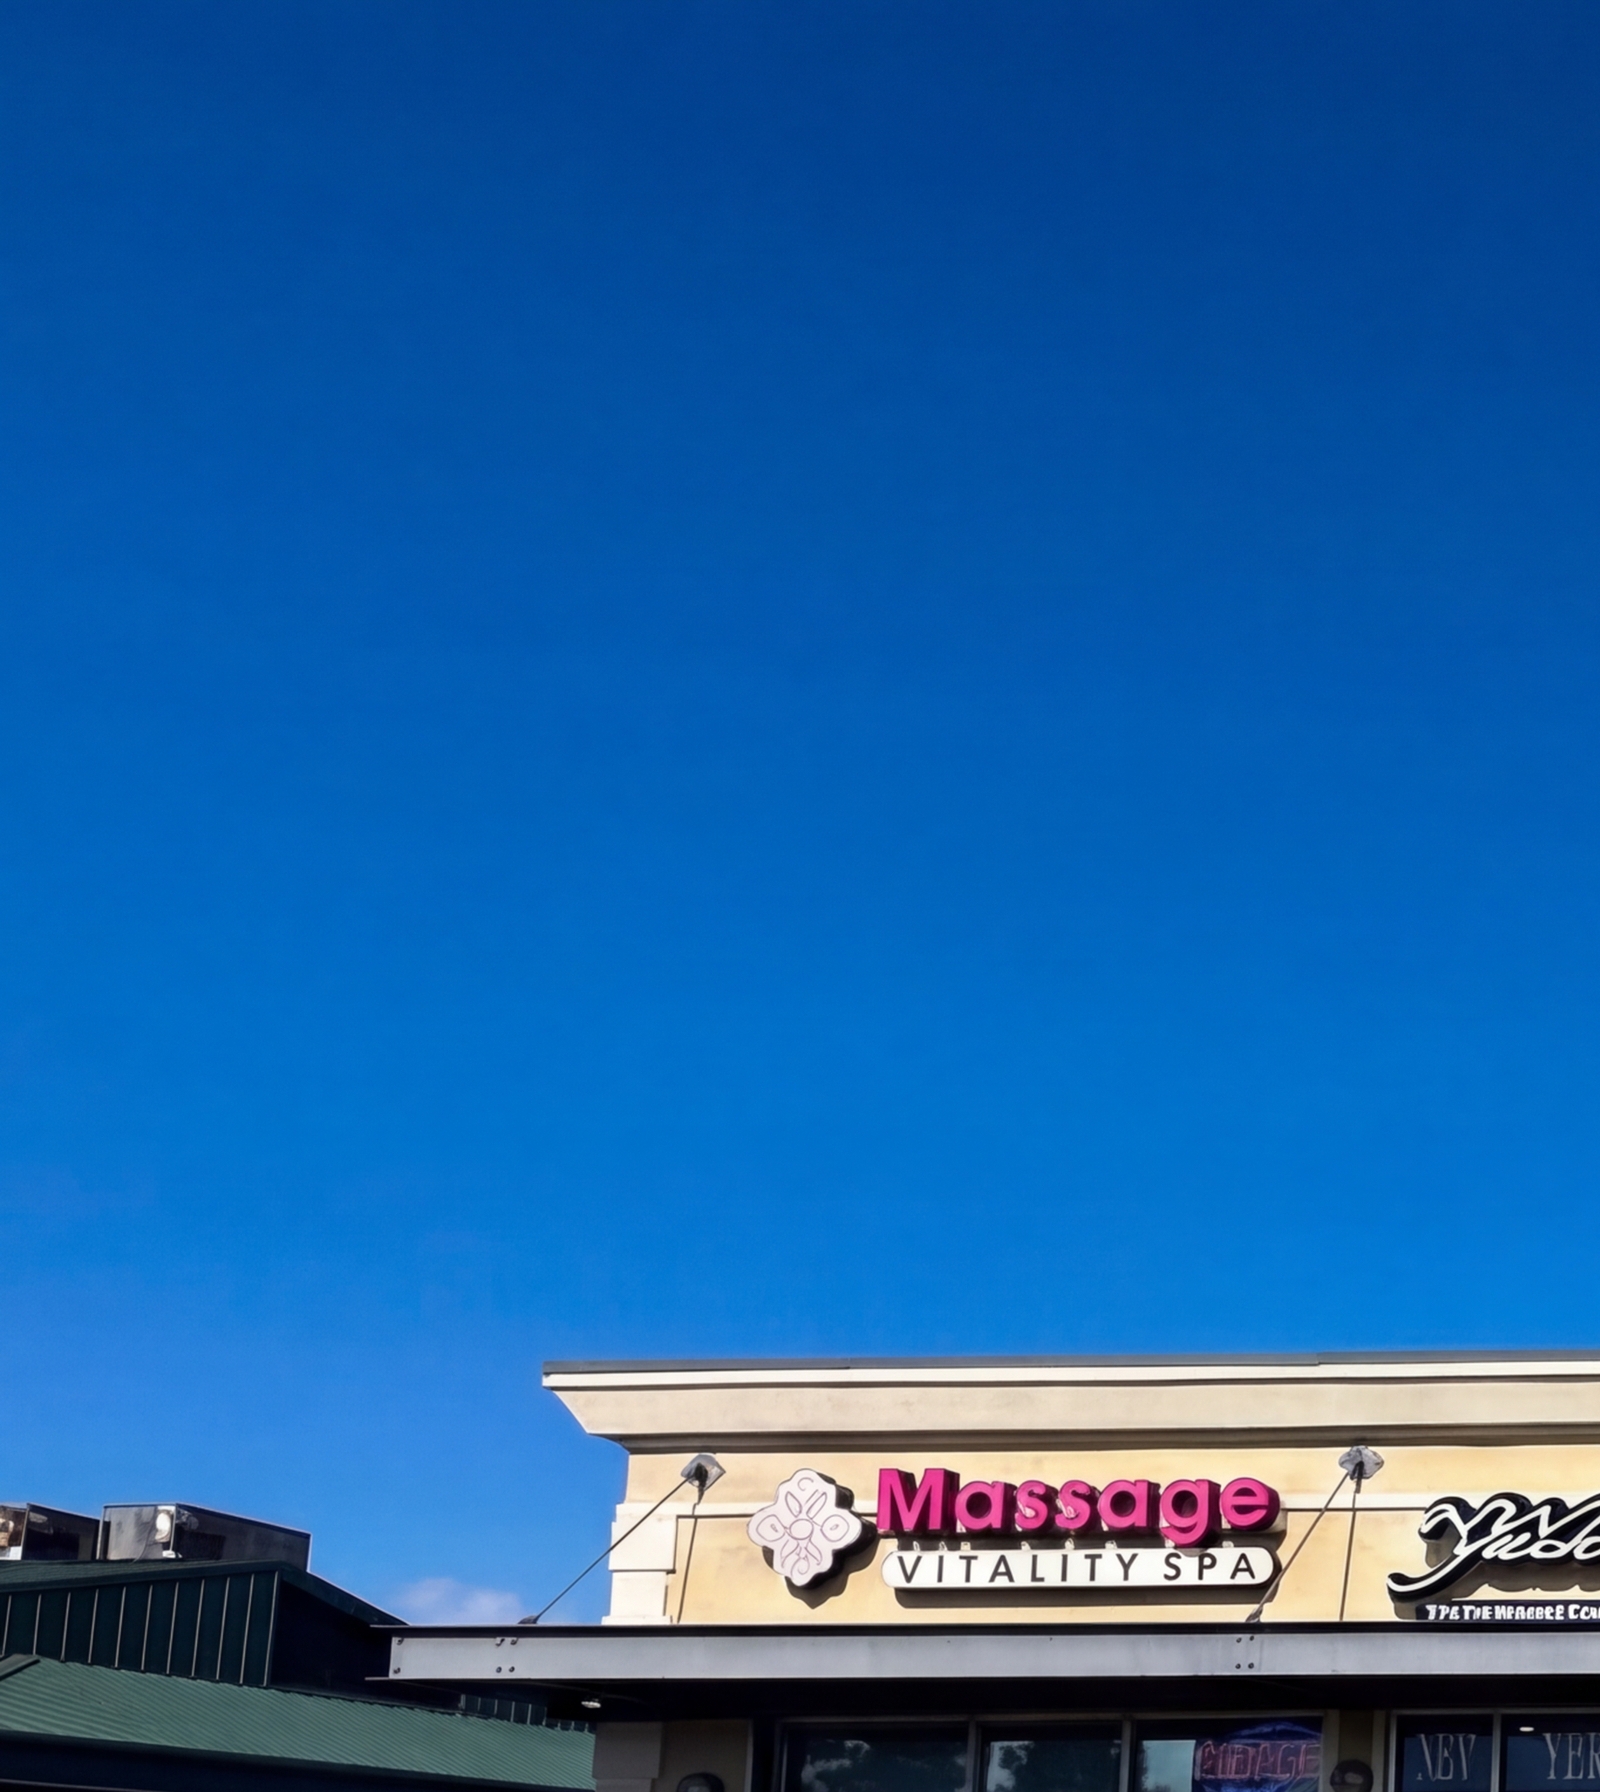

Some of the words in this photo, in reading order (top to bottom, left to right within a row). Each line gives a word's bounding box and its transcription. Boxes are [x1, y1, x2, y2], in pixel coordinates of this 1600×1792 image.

[877, 1467, 1282, 1548] Massage
[896, 1553, 1139, 1585] VITALITY
[1163, 1552, 1258, 1582] SPA
